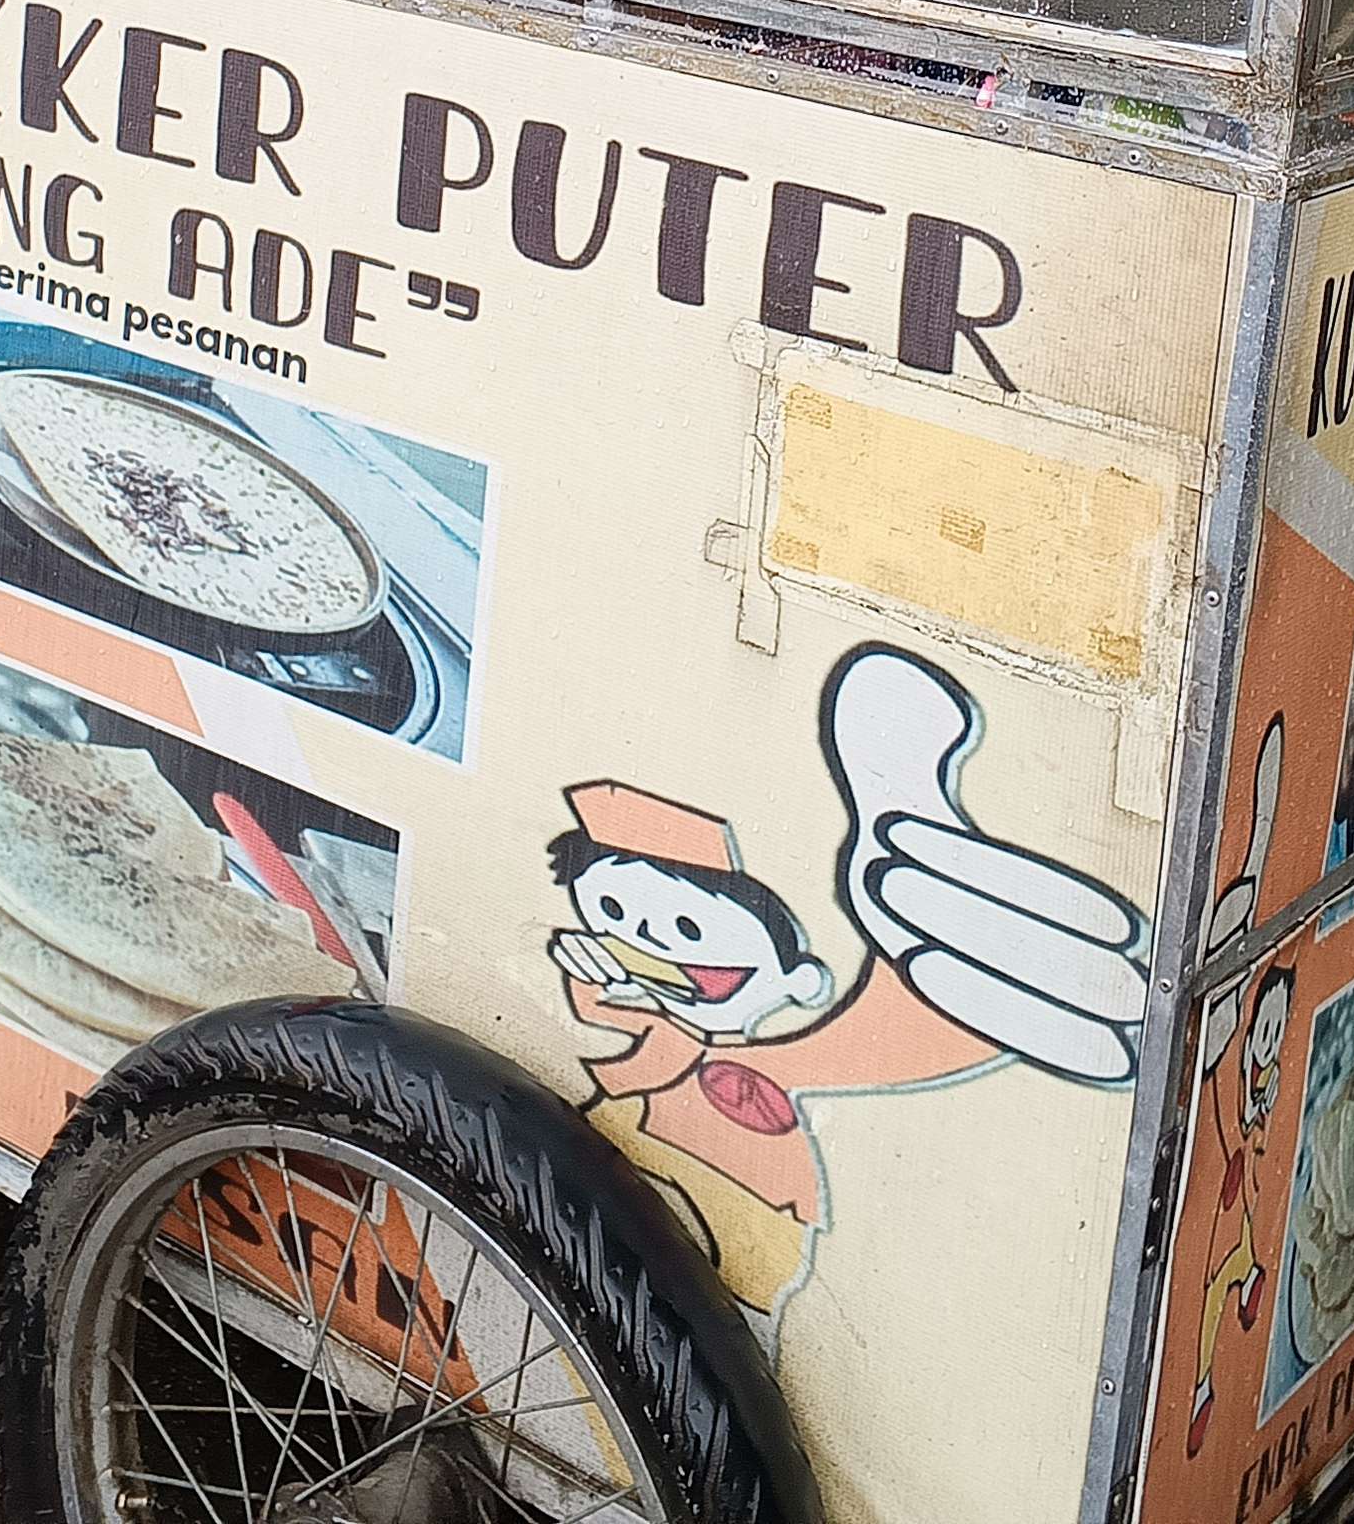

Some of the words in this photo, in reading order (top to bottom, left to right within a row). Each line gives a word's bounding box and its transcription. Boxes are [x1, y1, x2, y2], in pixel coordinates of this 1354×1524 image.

[395, 91, 1022, 394] PUTER
[123, 300, 309, 385] pesanan
[1235, 1396, 1318, 1524] ENAK
